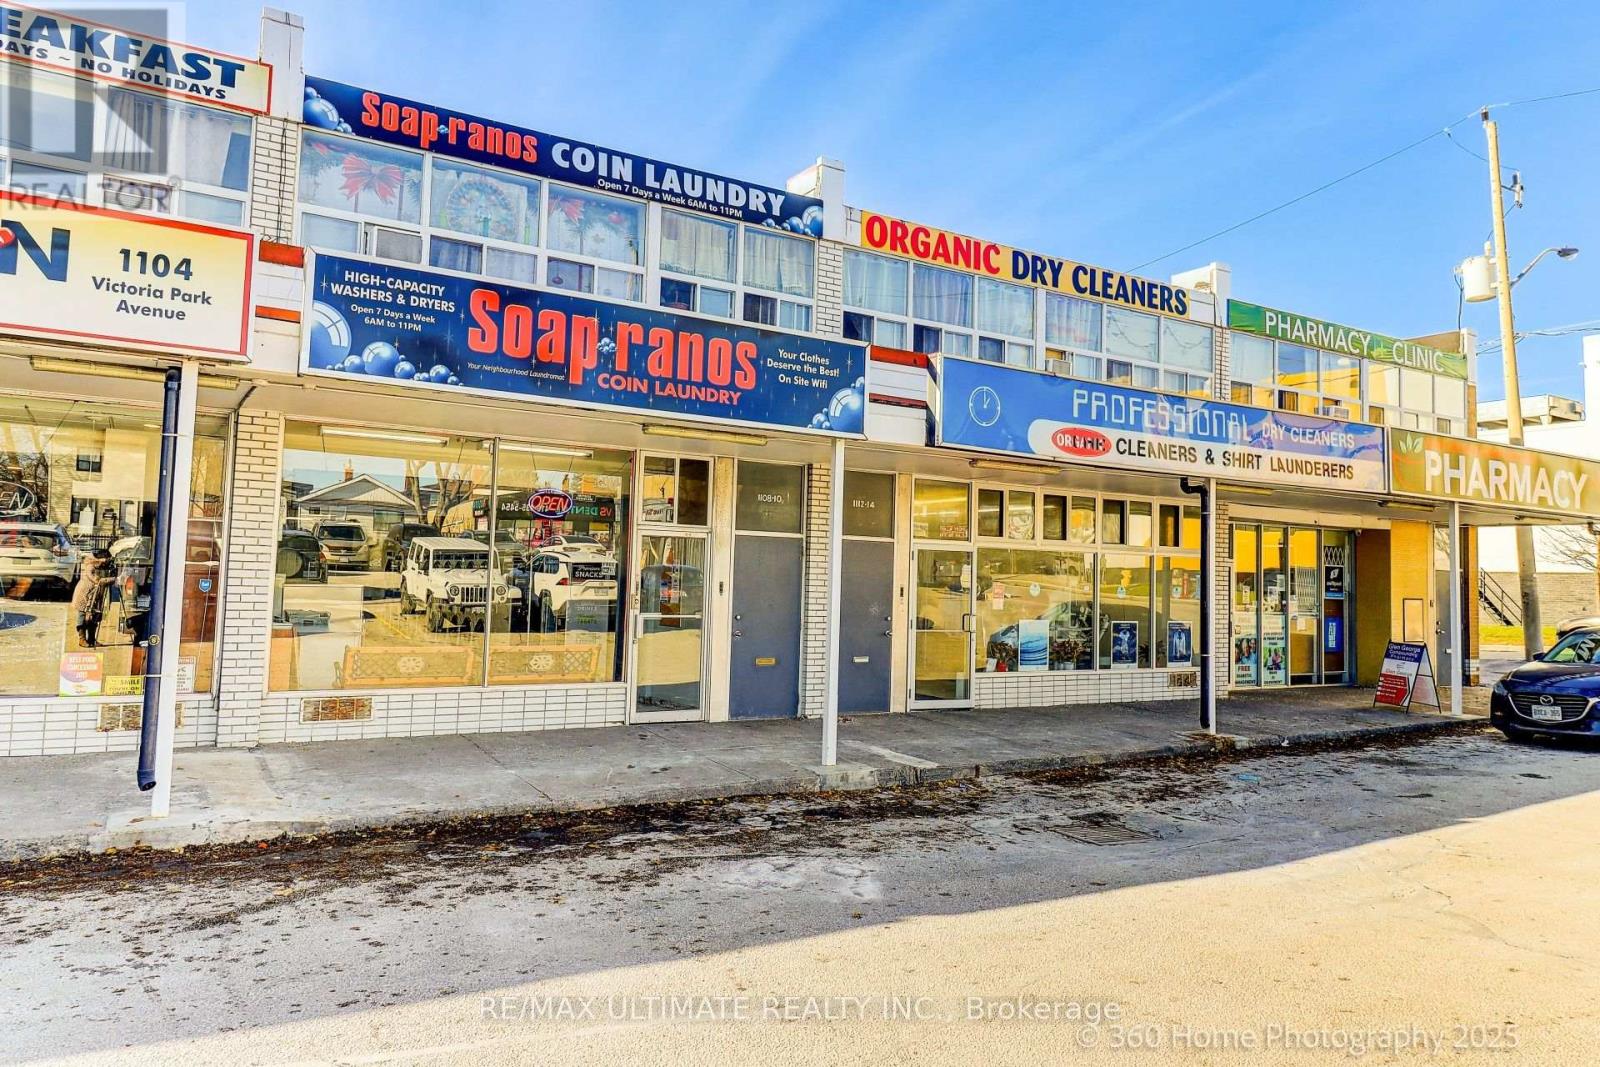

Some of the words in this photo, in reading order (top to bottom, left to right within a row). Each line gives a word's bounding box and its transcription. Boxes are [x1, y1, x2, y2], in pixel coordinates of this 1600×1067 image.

[81, 58, 112, 73] NO
[122, 68, 227, 99] HOLIDAYS
[551, 142, 633, 183] COIN
[645, 163, 786, 217] LAUNDRY
[597, 178, 622, 192] Open
[623, 184, 630, 193] 7
[632, 186, 654, 201] Days
[654, 191, 661, 199] a
[662, 192, 686, 206] Week
[687, 198, 707, 211] 6AM
[709, 203, 718, 213] to
[720, 206, 743, 219] 11PM
[119, 248, 193, 281] 1104
[865, 215, 1000, 275] ORGANIC
[1012, 250, 1063, 289] DRY
[1072, 265, 1187, 316] CLEANERS
[92, 276, 165, 299] Victoria
[170, 287, 212, 305] Park
[344, 270, 446, 296] HIGH-CAPACITY
[116, 299, 186, 321] Avenue
[331, 283, 393, 303] WASHERS
[396, 293, 406, 304] &
[410, 296, 456, 313] DRYERS
[351, 303, 373, 316] Open
[376, 307, 382, 316] 7
[383, 308, 404, 321] Days
[412, 313, 436, 324] Week
[364, 317, 385, 328] 6AM
[388, 320, 397, 329] to
[398, 321, 422, 332] 11PM
[1265, 311, 1371, 356] PHARMACY
[1392, 341, 1445, 373] CLINIC
[767, 358, 802, 372] Deserve
[803, 362, 818, 374] the
[819, 365, 840, 378] Best!
[778, 348, 798, 360] Your
[799, 351, 830, 366] Clothes
[597, 373, 648, 394] COIN
[654, 382, 742, 405] LAUNDRY
[778, 374, 792, 384] On
[793, 375, 809, 387] Site
[1262, 423, 1286, 442] DRY
[1289, 427, 1356, 449] CLEANERS
[1115, 437, 1198, 463] CLEANERS
[1205, 449, 1215, 465] &
[1222, 450, 1263, 470] SHIRT
[1270, 456, 1355, 480] LAUNDERERS
[1424, 450, 1588, 510] PHARMACY
[530, 495, 571, 512] OPEN
